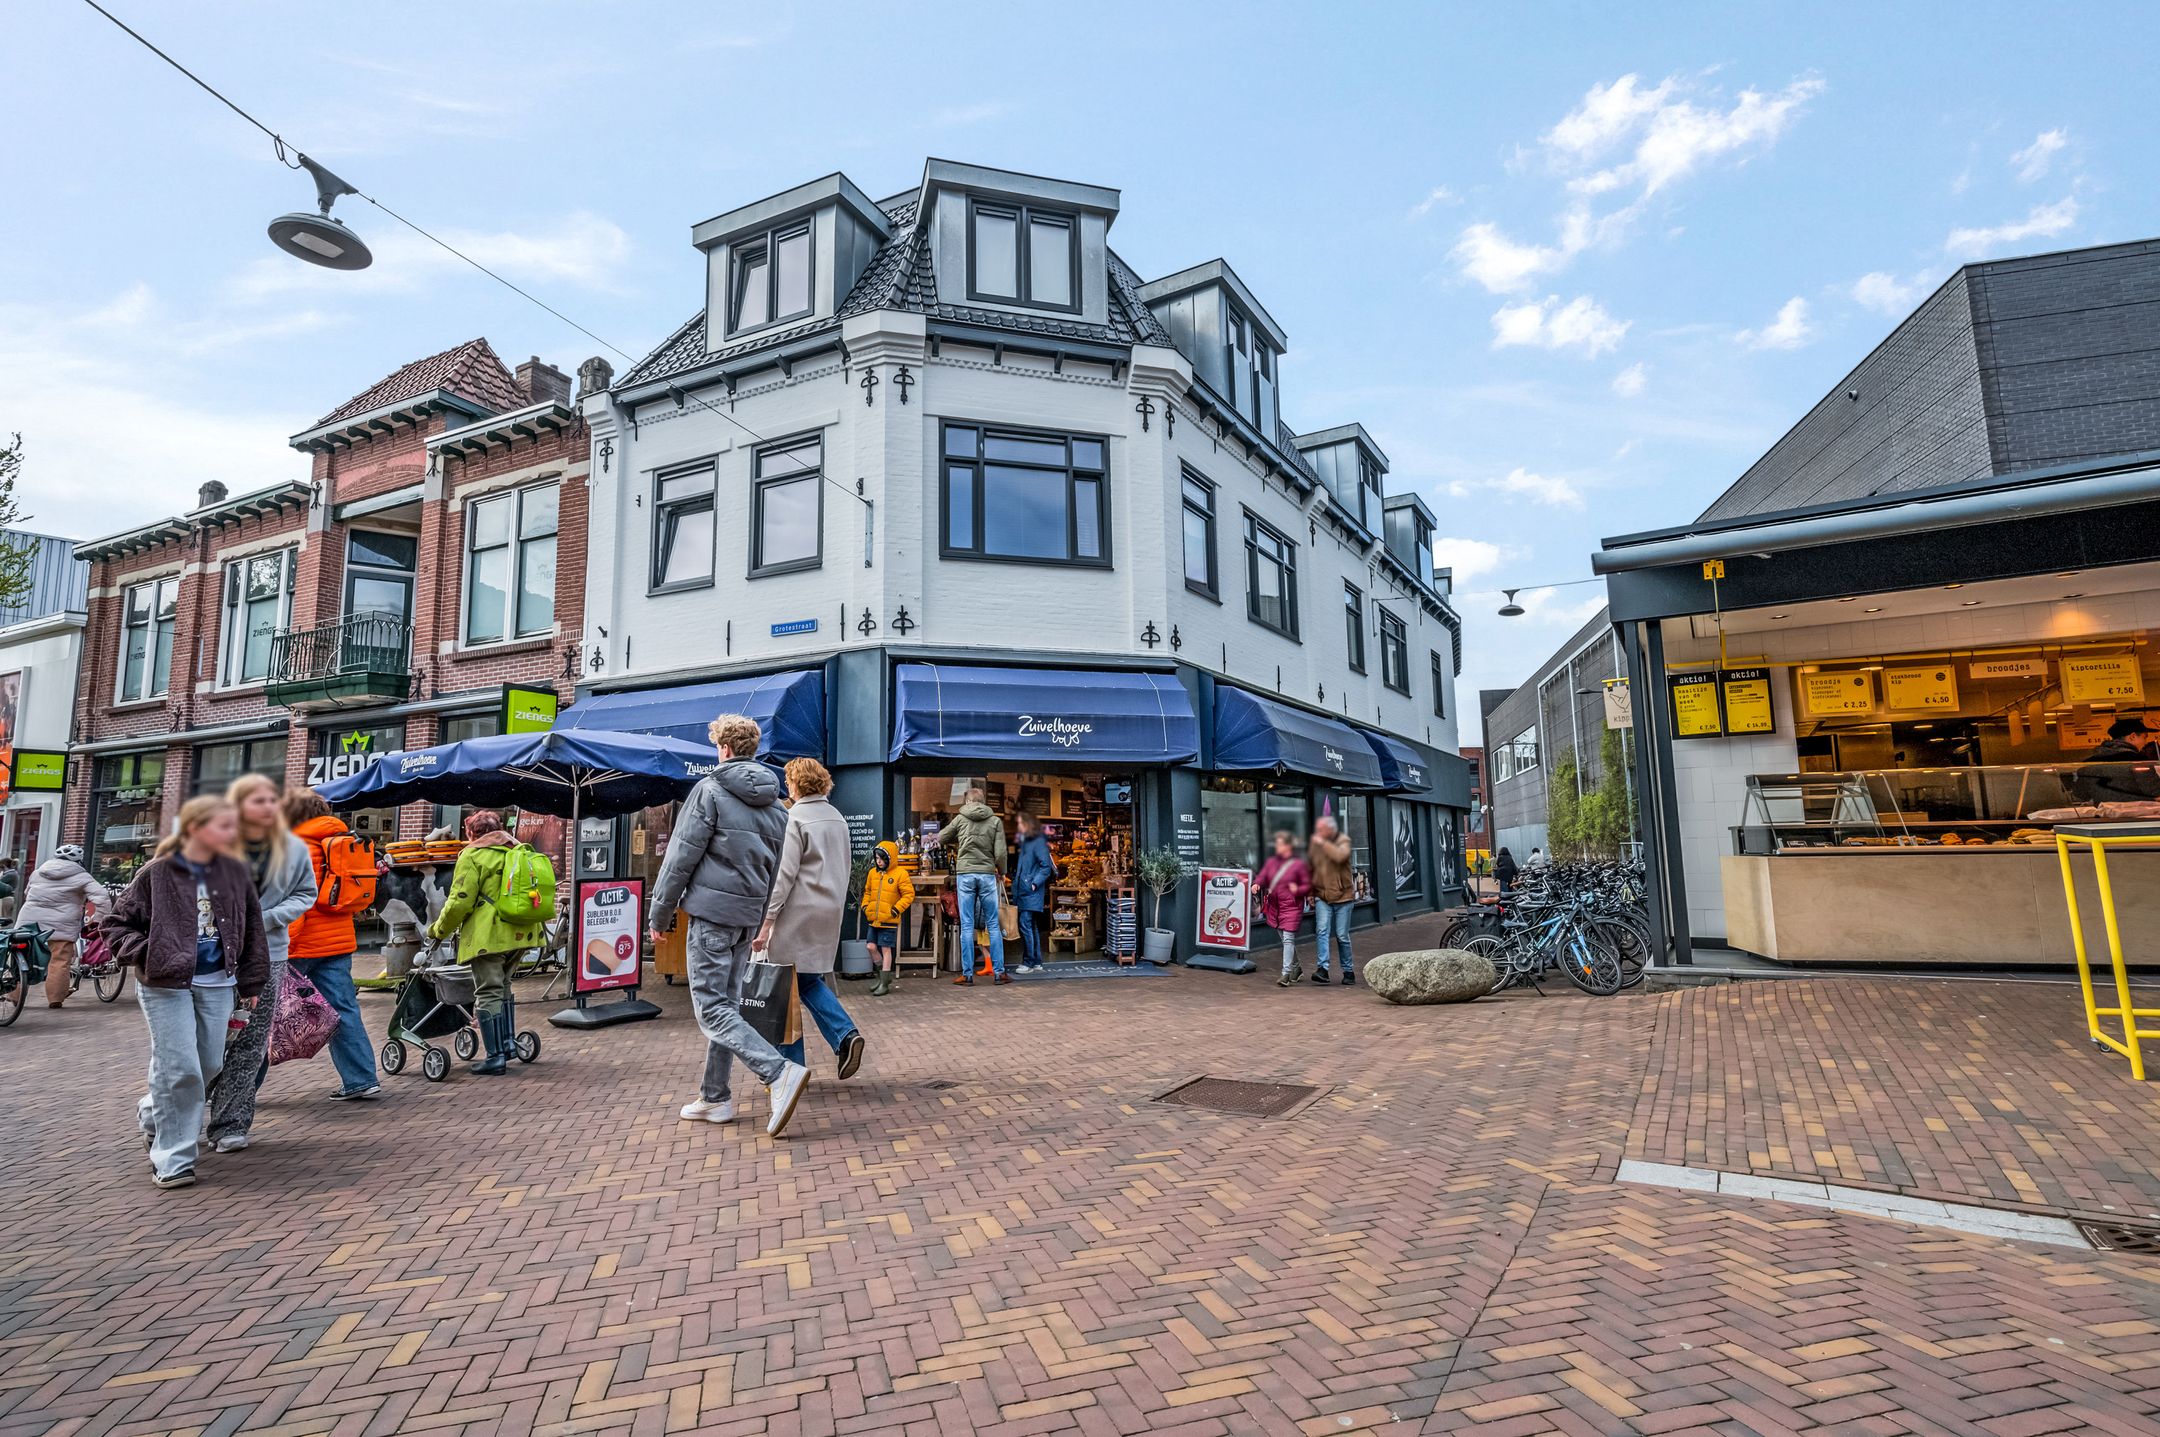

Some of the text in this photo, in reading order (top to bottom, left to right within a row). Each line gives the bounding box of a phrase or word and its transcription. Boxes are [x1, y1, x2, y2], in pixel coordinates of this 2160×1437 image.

[774, 622, 812, 632] Grotestraat
[1987, 664, 2030, 672] broodjes
[2070, 663, 2121, 671] kiptortilla
[1679, 675, 1707, 684] aktie!
[1730, 670, 1760, 679] aktie!
[515, 710, 554, 723] ZIENGS
[1613, 715, 1630, 723] kipp
[1018, 715, 1093, 737] Zuivelhoeve
[22, 767, 62, 775] ZIENGS
[307, 750, 404, 785] ZIEN
[1216, 877, 1234, 887] ACTIE
[601, 889, 624, 905] ACTIE
[586, 909, 609, 919] SUBLIEM
[586, 917, 609, 927] BELEGEN
[744, 998, 766, 1008] STING
